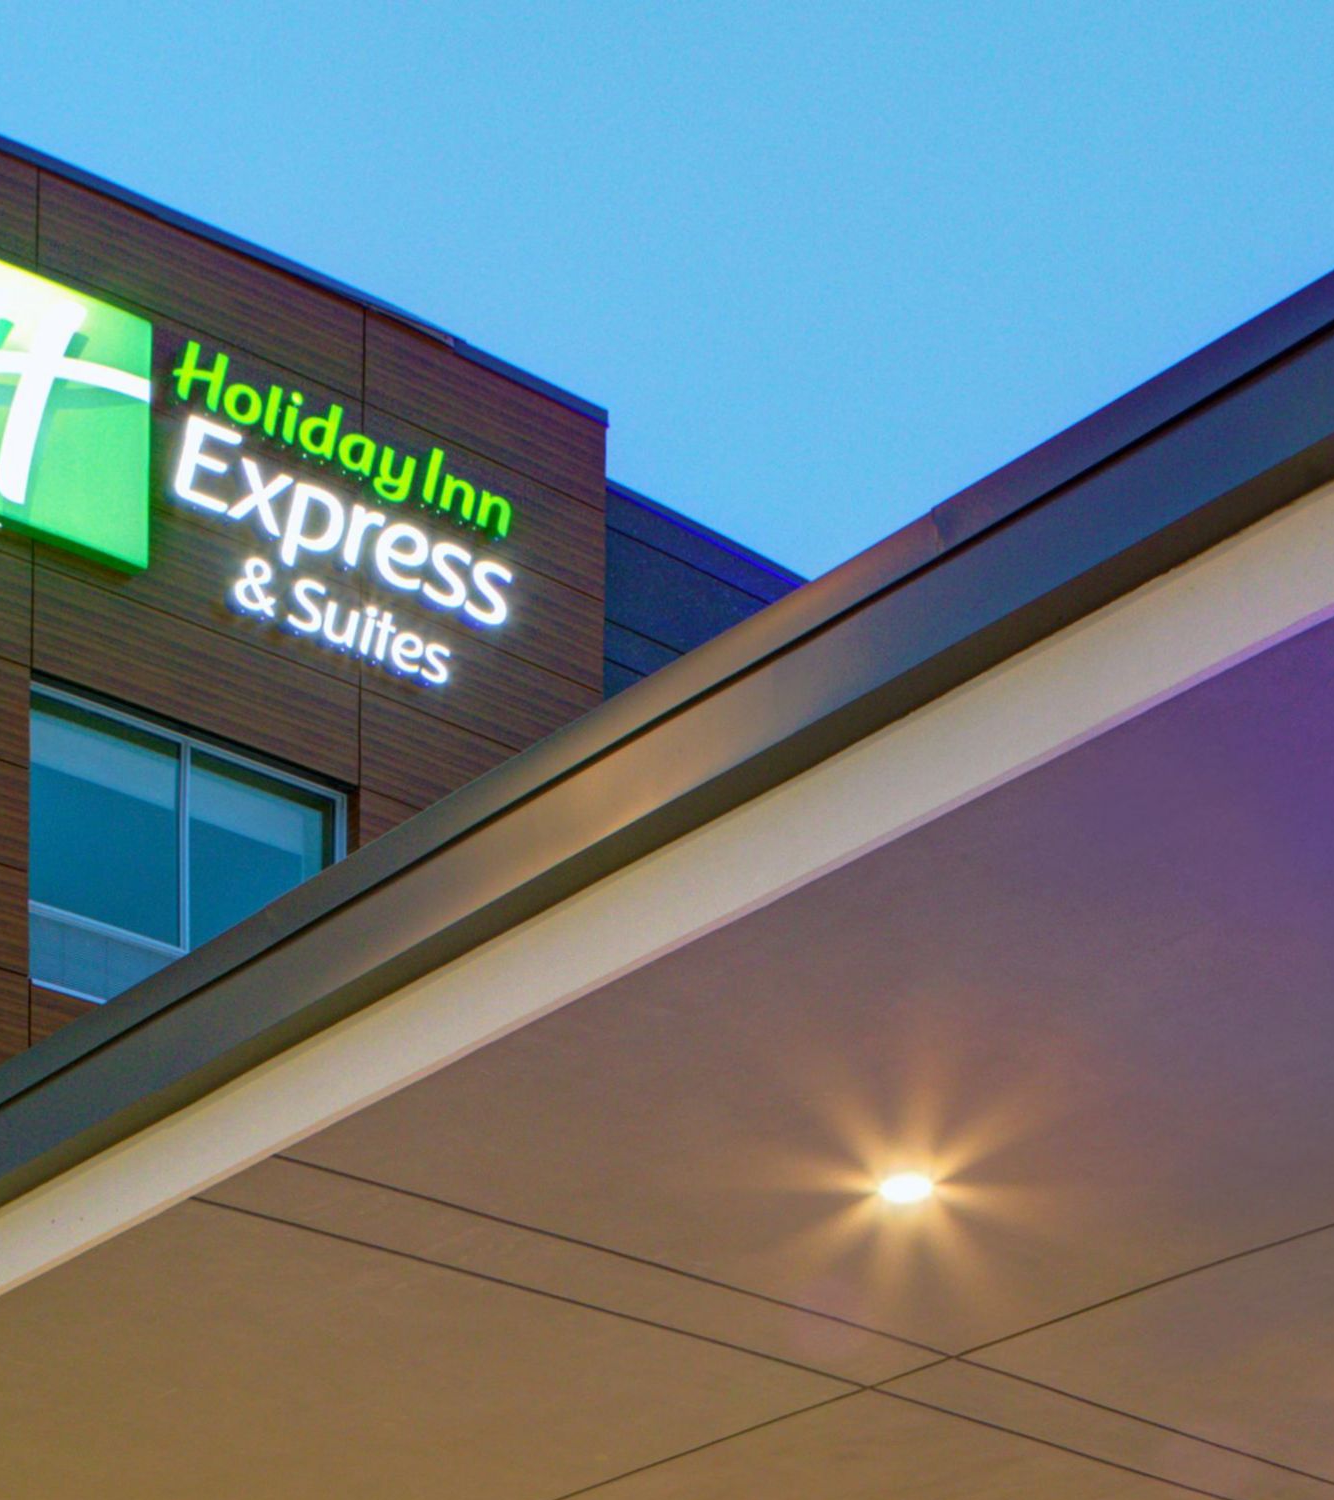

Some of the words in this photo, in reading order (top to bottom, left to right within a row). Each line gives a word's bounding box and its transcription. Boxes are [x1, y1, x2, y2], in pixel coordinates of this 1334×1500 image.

[173, 340, 415, 503] Holiday
[422, 448, 513, 538] Inn
[174, 414, 513, 628] Express
[233, 556, 277, 617] &
[288, 578, 452, 685] Suites
